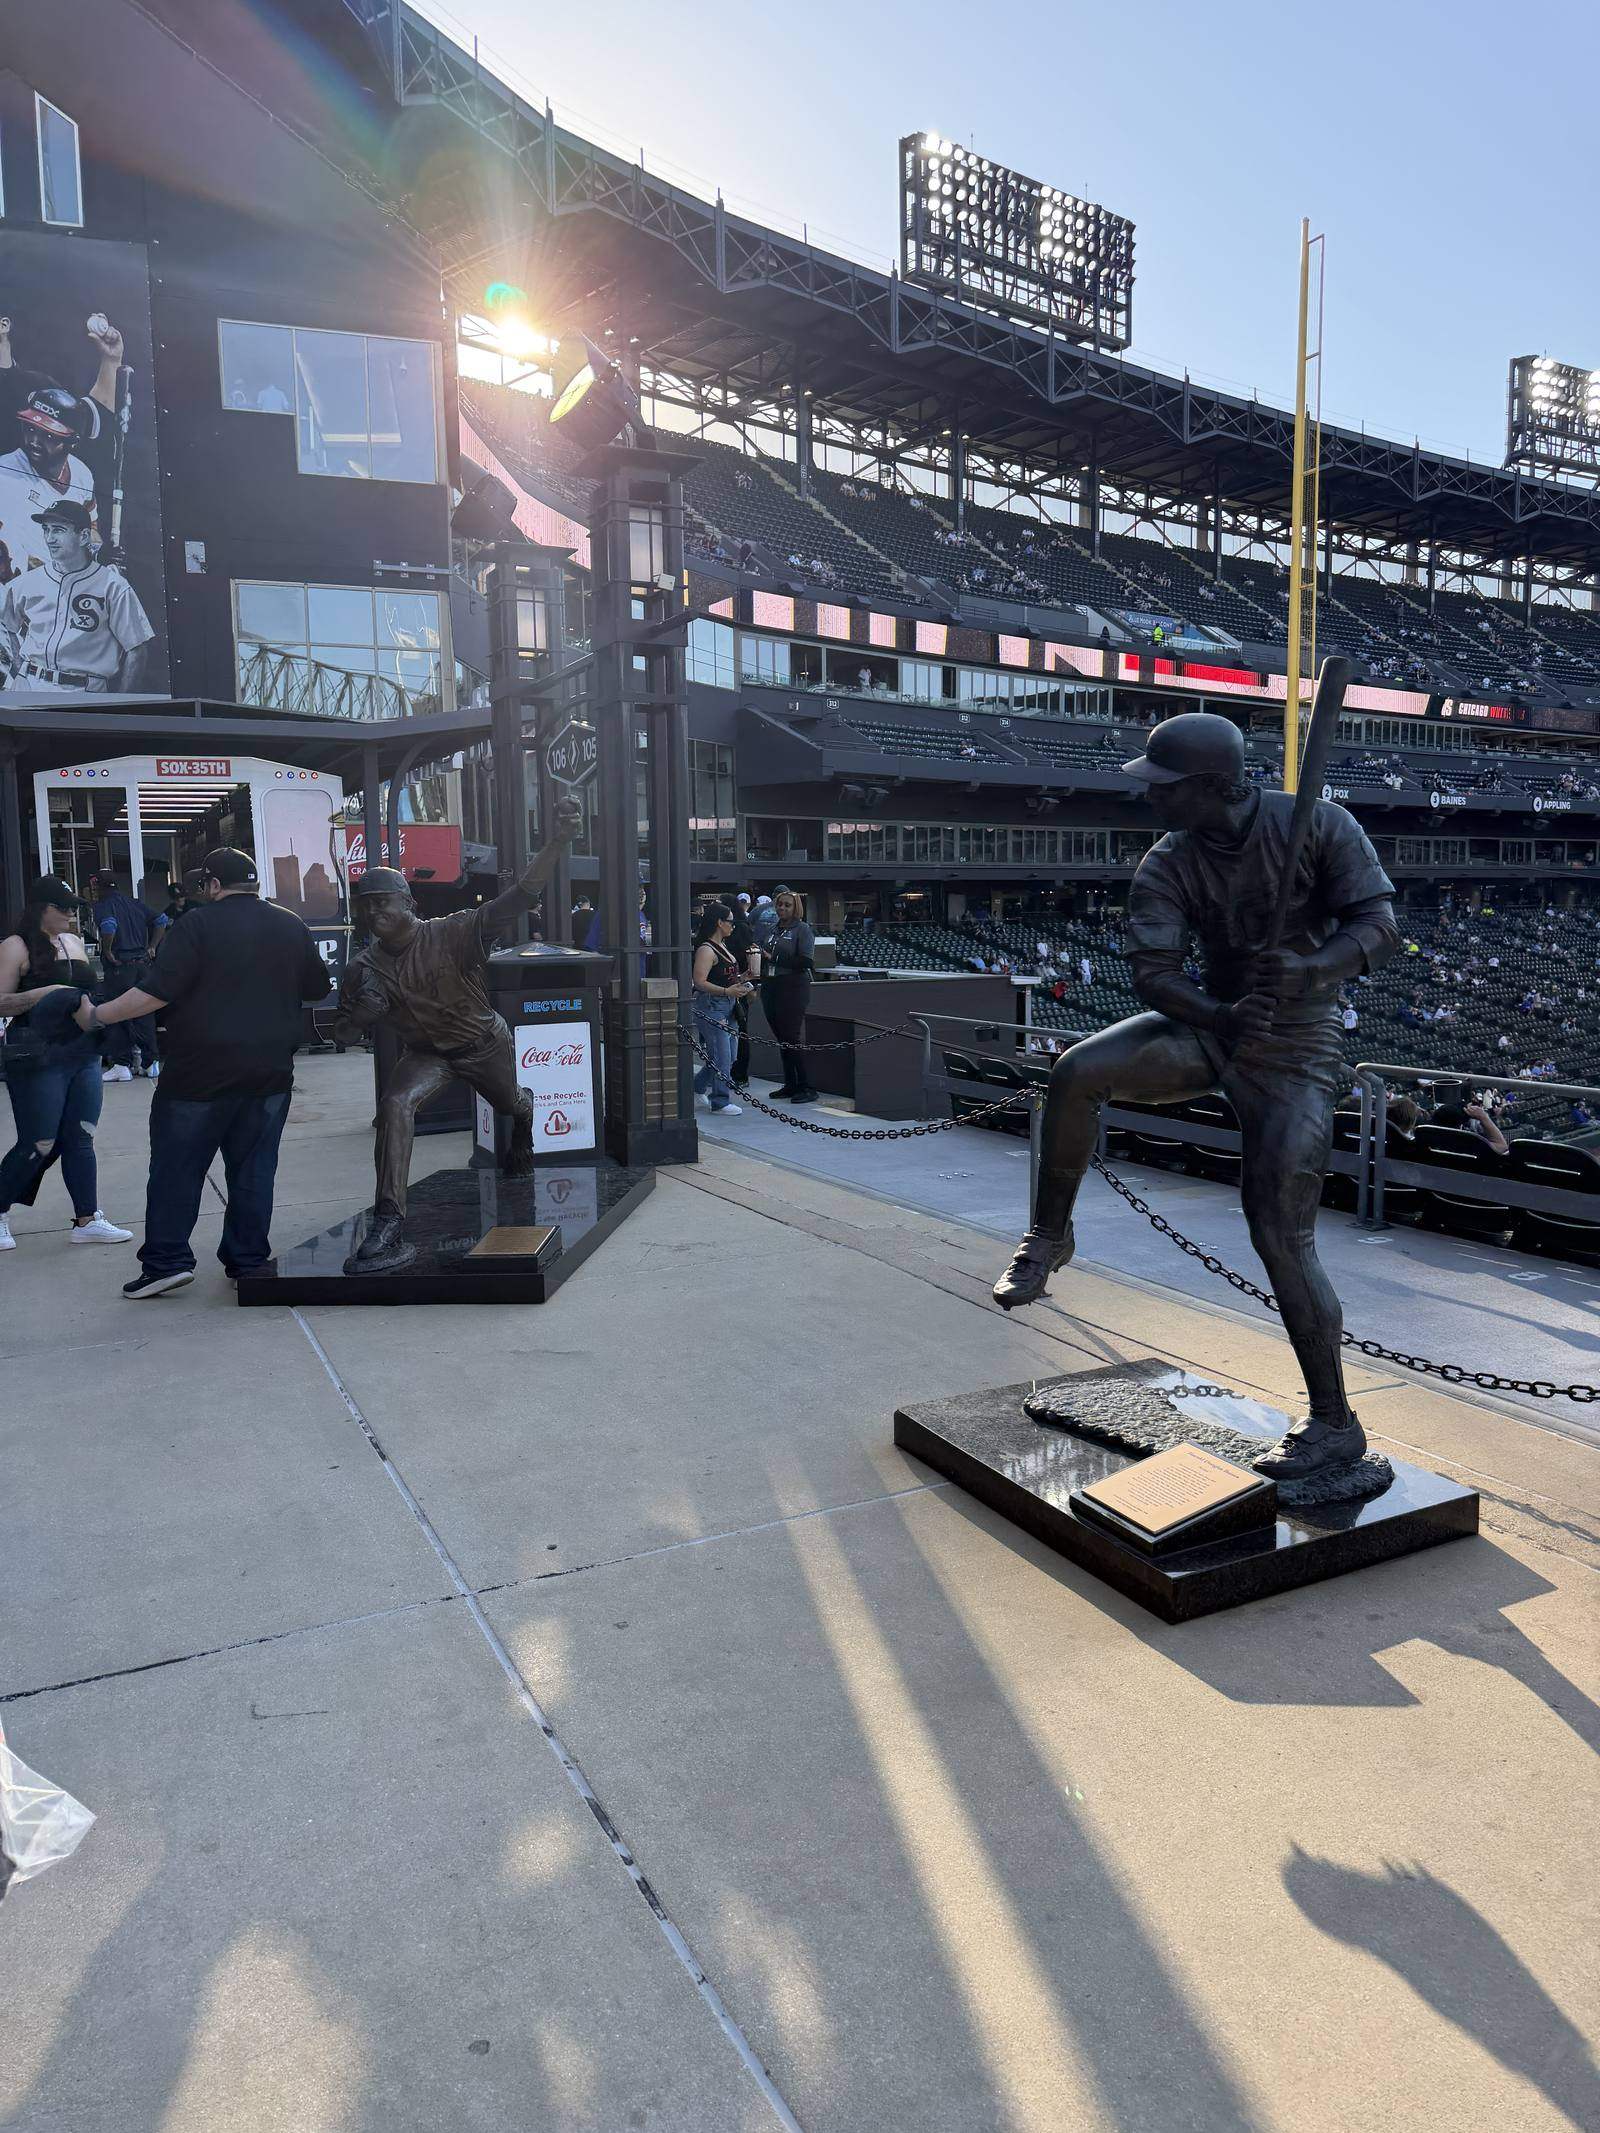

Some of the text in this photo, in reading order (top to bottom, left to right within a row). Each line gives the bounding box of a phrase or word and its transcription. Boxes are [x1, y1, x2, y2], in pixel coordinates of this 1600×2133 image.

[33, 400, 60, 418] SOX
[1458, 702, 1489, 718] CHICAGO
[552, 736, 597, 771] 106 105
[160, 761, 226, 774] SOX-35TH
[1333, 789, 1349, 799] FOX
[1441, 795, 1466, 806] BAINES
[1543, 800, 1571, 810] APPLING
[523, 999, 582, 1013] RECYCLE
